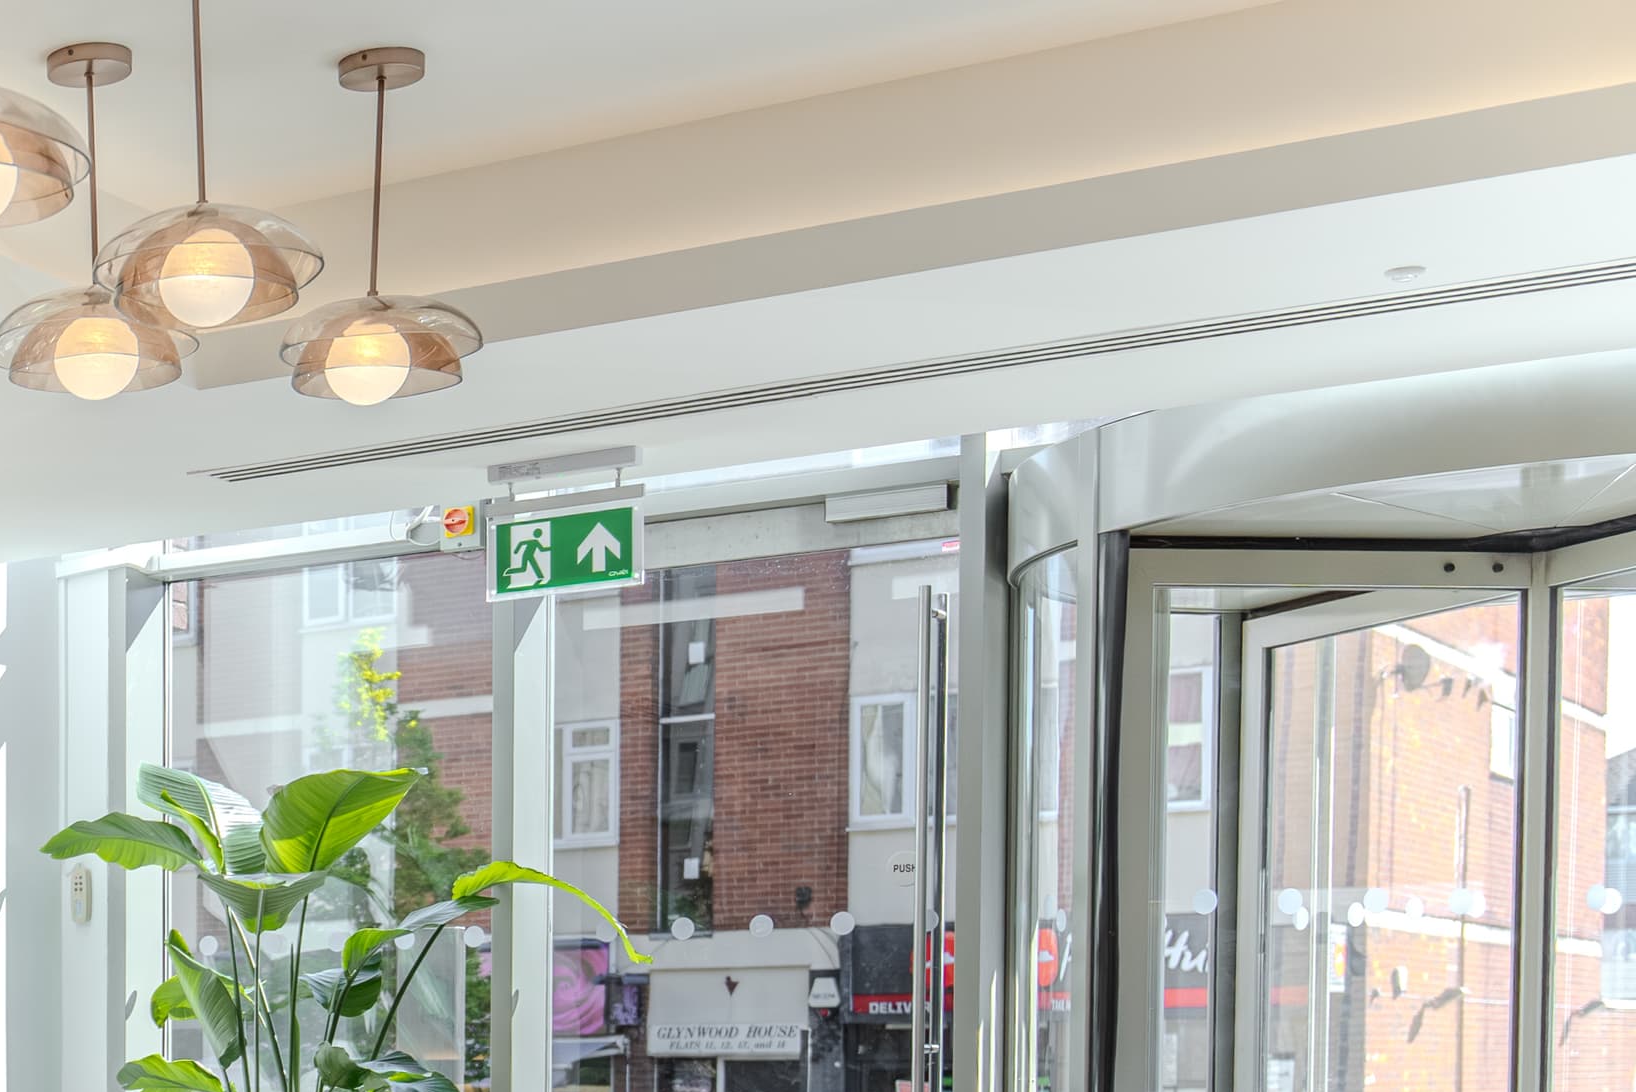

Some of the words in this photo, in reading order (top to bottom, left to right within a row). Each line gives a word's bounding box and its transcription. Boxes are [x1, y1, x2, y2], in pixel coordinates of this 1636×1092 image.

[1164, 930, 1209, 973] Hu
[656, 1025, 739, 1040] GLYNWOOD
[746, 1024, 799, 1039] HOUSE
[669, 1041, 700, 1050] FLATS
[754, 1040, 772, 1049] and
